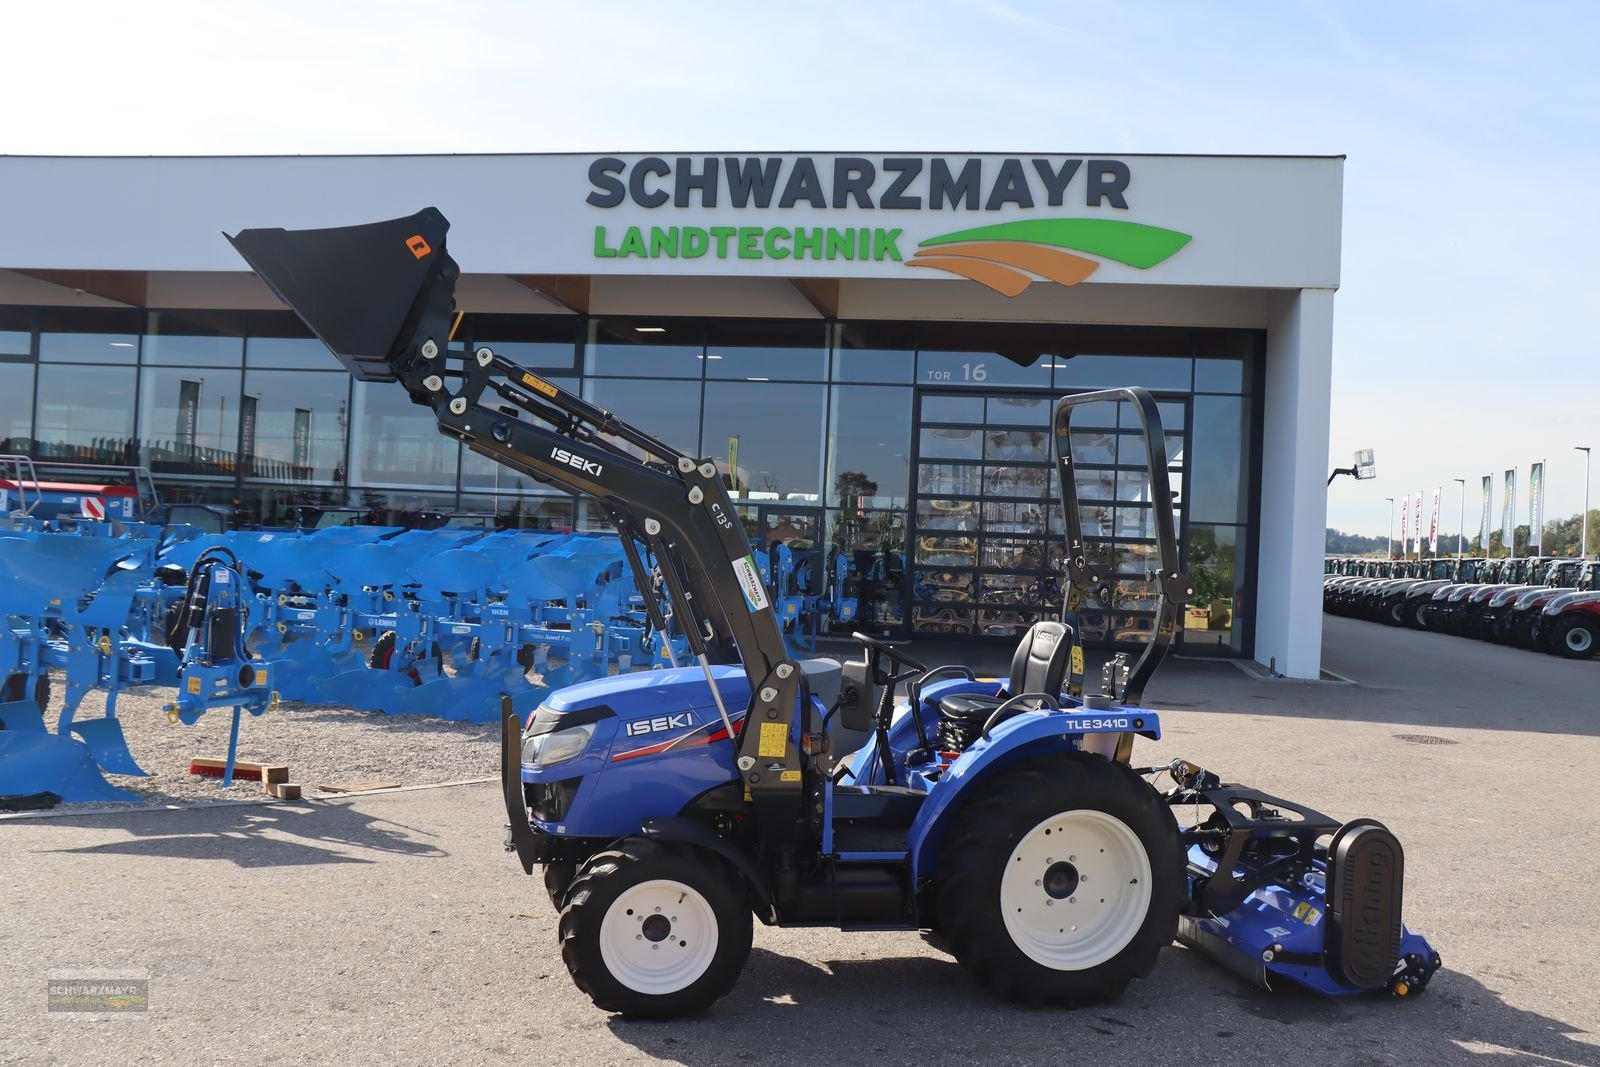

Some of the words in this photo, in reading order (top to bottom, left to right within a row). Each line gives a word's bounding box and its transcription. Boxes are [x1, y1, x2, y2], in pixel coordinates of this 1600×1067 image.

[585, 157, 1131, 211] SCHWARZMAYR
[594, 225, 903, 262] LANDTECHNIK
[927, 370, 951, 380] TOR
[962, 363, 987, 382] 16
[550, 446, 603, 477] ISEKI
[743, 561, 762, 602] SCHWARZMAYR
[375, 619, 397, 627] LEMKE
[626, 712, 694, 737] ISEKI
[1066, 718, 1128, 730] TLE3410
